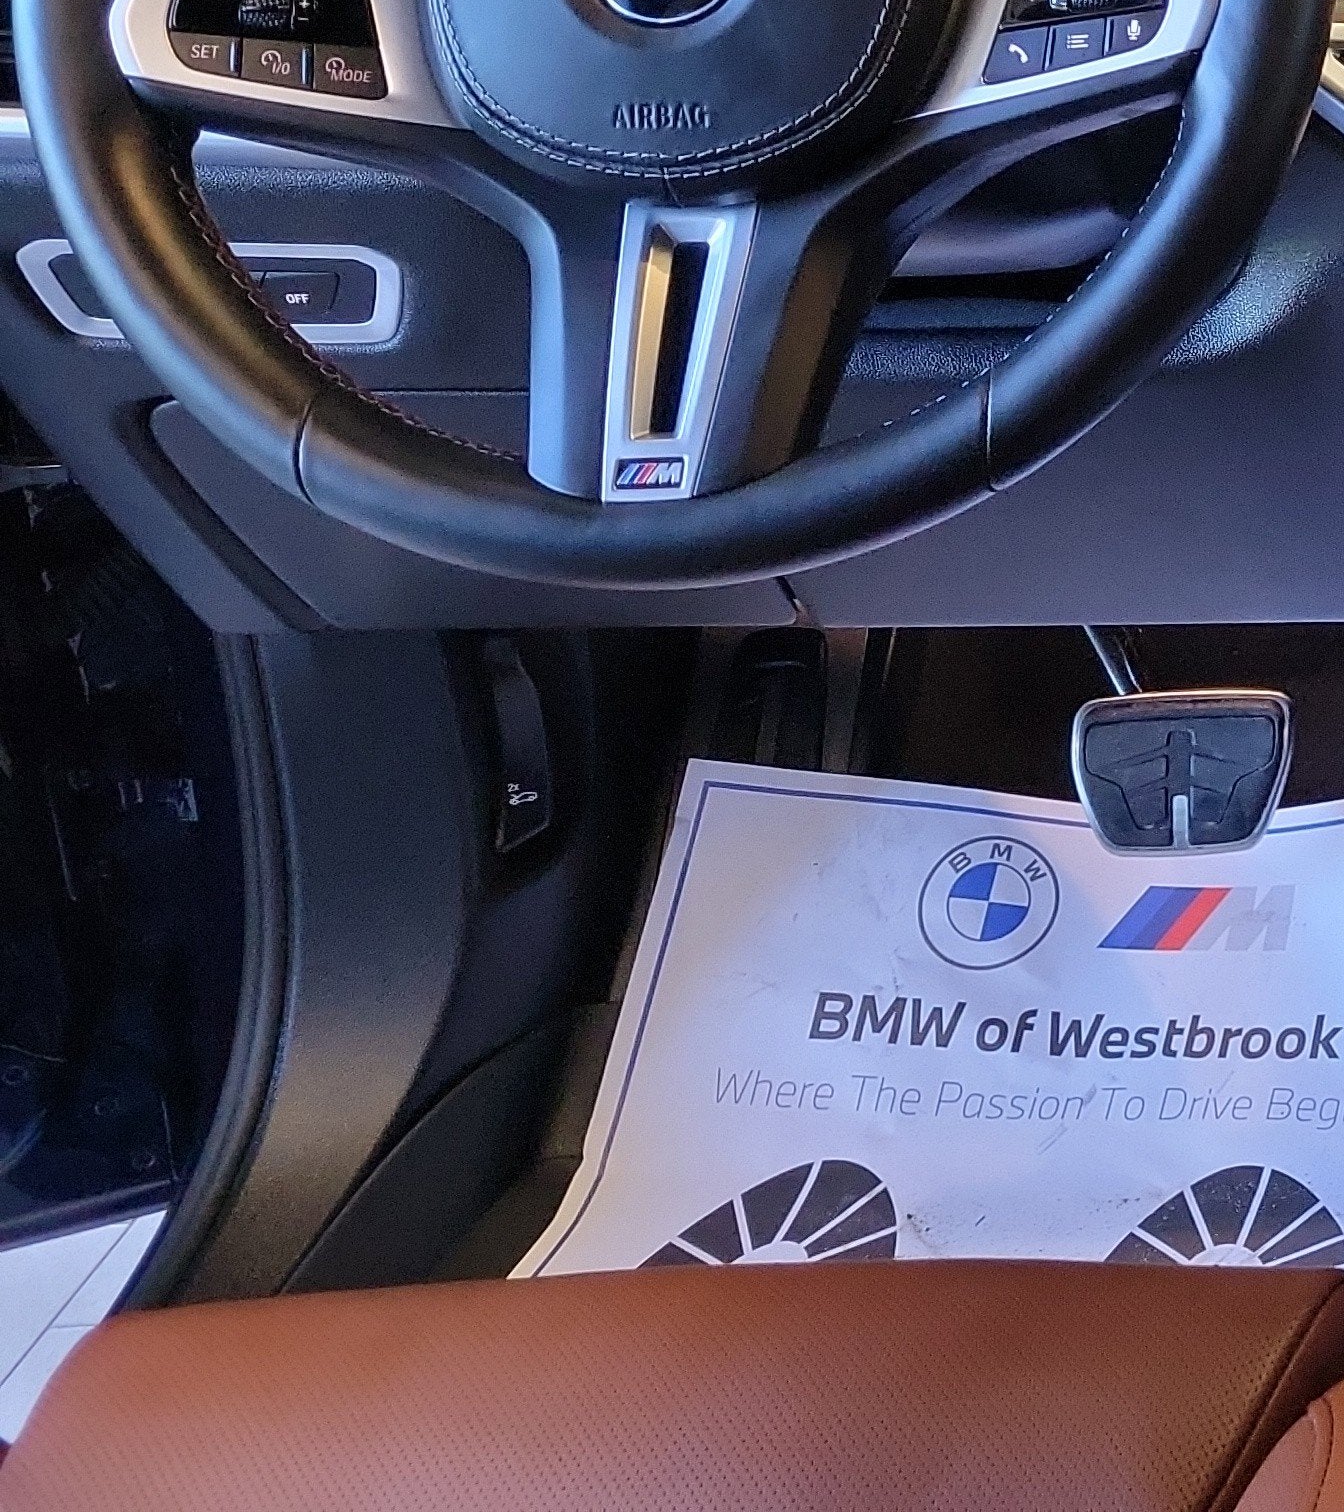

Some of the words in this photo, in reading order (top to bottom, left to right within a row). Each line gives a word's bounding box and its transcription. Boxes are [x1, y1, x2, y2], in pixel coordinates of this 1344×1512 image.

[191, 45, 219, 59] SET
[330, 68, 373, 83] MODE
[613, 102, 710, 129] AIRBAG
[285, 293, 309, 304] OFF
[948, 843, 1047, 882] BMW
[808, 992, 966, 1048] BMW
[975, 1008, 1038, 1053] of
[1049, 1011, 1343, 1060] Westbrook
[715, 1067, 835, 1110] Where
[852, 1074, 921, 1116] The
[935, 1080, 1084, 1121] Passion
[1101, 1087, 1146, 1121] To
[1159, 1087, 1253, 1121] Drive
